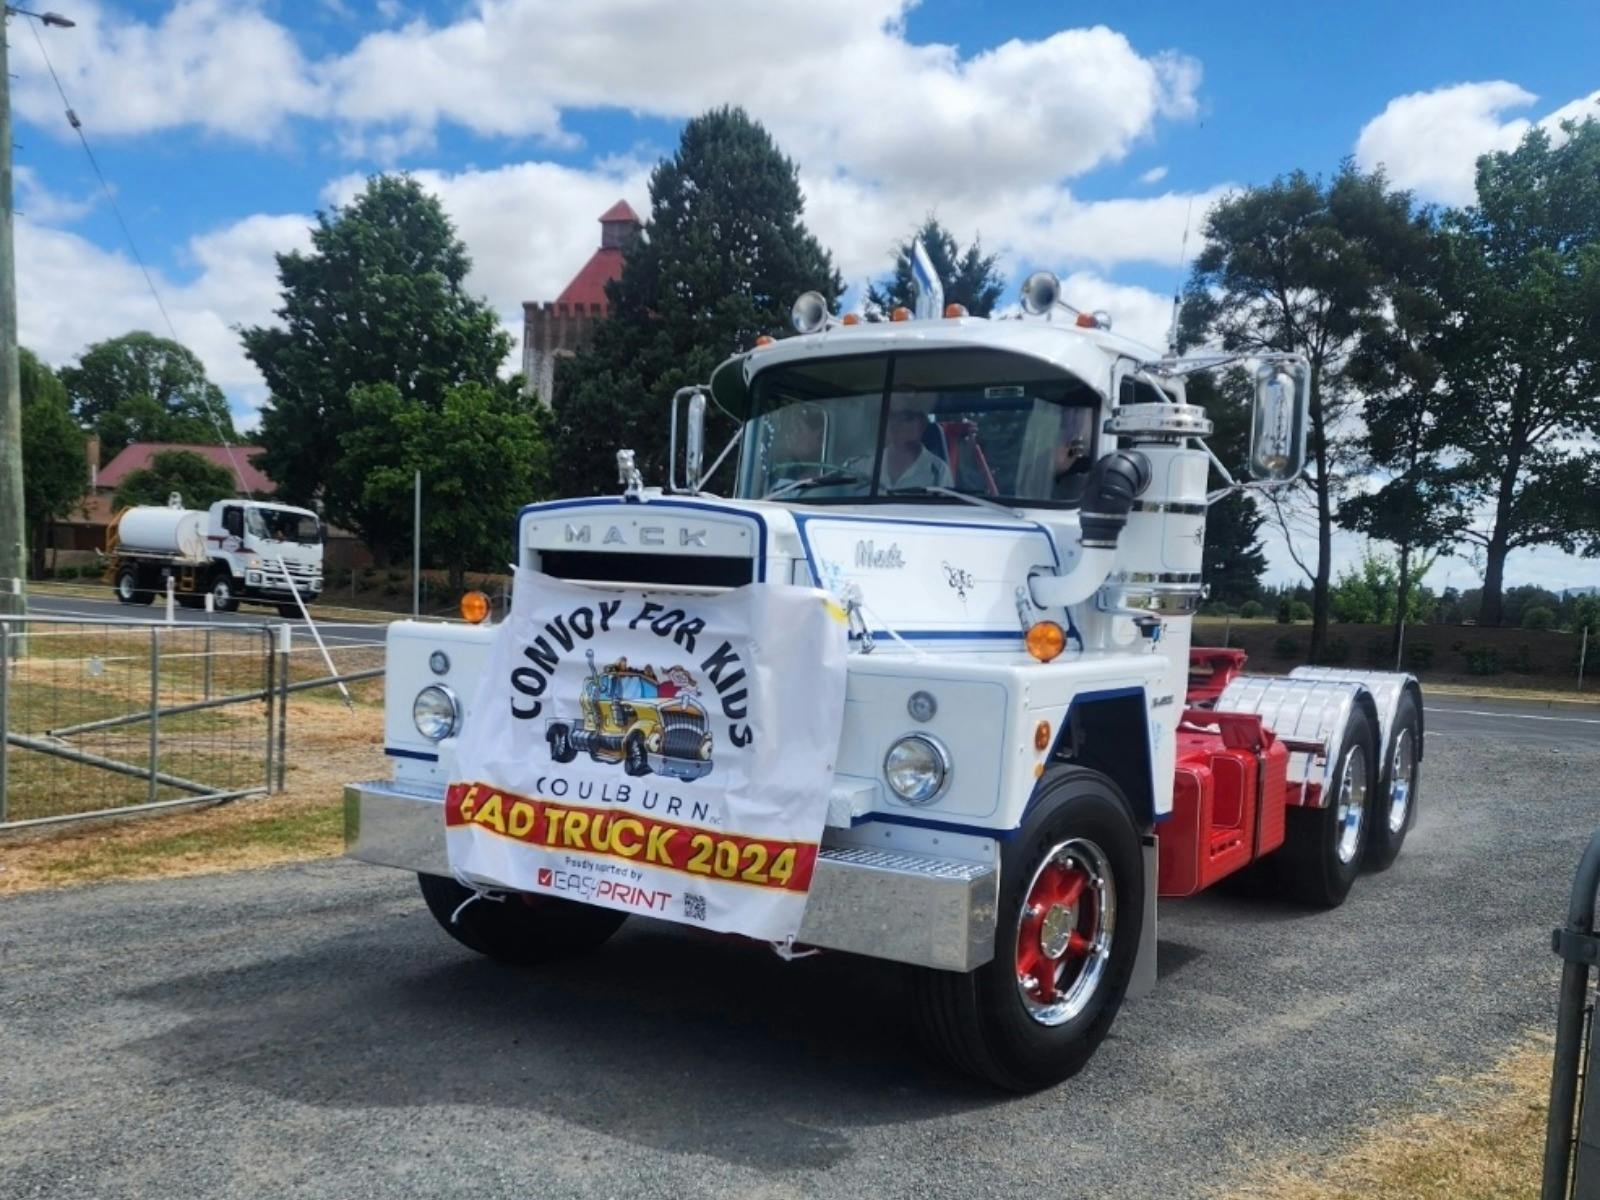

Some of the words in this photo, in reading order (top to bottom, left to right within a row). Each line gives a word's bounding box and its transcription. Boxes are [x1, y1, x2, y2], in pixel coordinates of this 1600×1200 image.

[564, 523, 707, 547] MACK
[510, 600, 621, 720] CONVOY
[628, 601, 706, 654] FOR
[700, 640, 753, 748] KIDS
[544, 807, 680, 866] TRUCK
[687, 834, 797, 886] 2024
[630, 869, 643, 882] by
